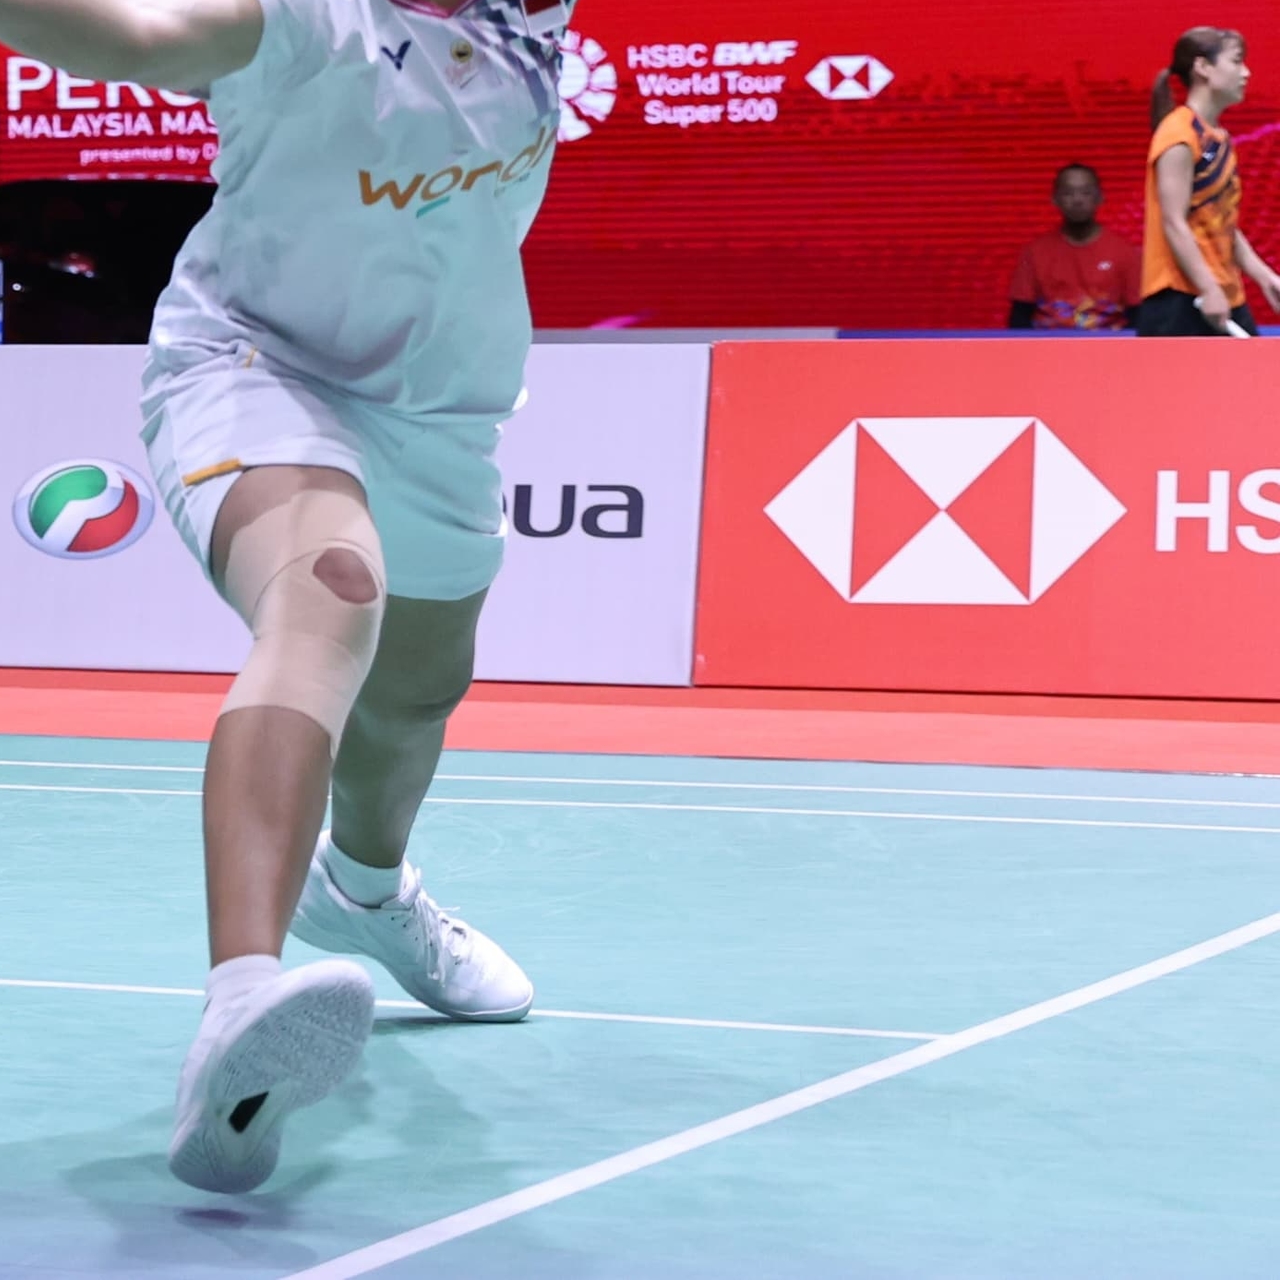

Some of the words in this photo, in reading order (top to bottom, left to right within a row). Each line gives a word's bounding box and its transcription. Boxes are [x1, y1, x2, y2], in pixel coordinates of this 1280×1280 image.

[627, 43, 708, 69] HSBC
[712, 40, 799, 66] BWF
[636, 71, 721, 97] World
[722, 70, 786, 94] Tour
[7, 111, 155, 139] MALAYSIA
[643, 99, 724, 128] Super
[726, 97, 778, 122] 500
[79, 144, 174, 166] presented
[175, 144, 201, 164] by
[502, 484, 645, 538] ua
